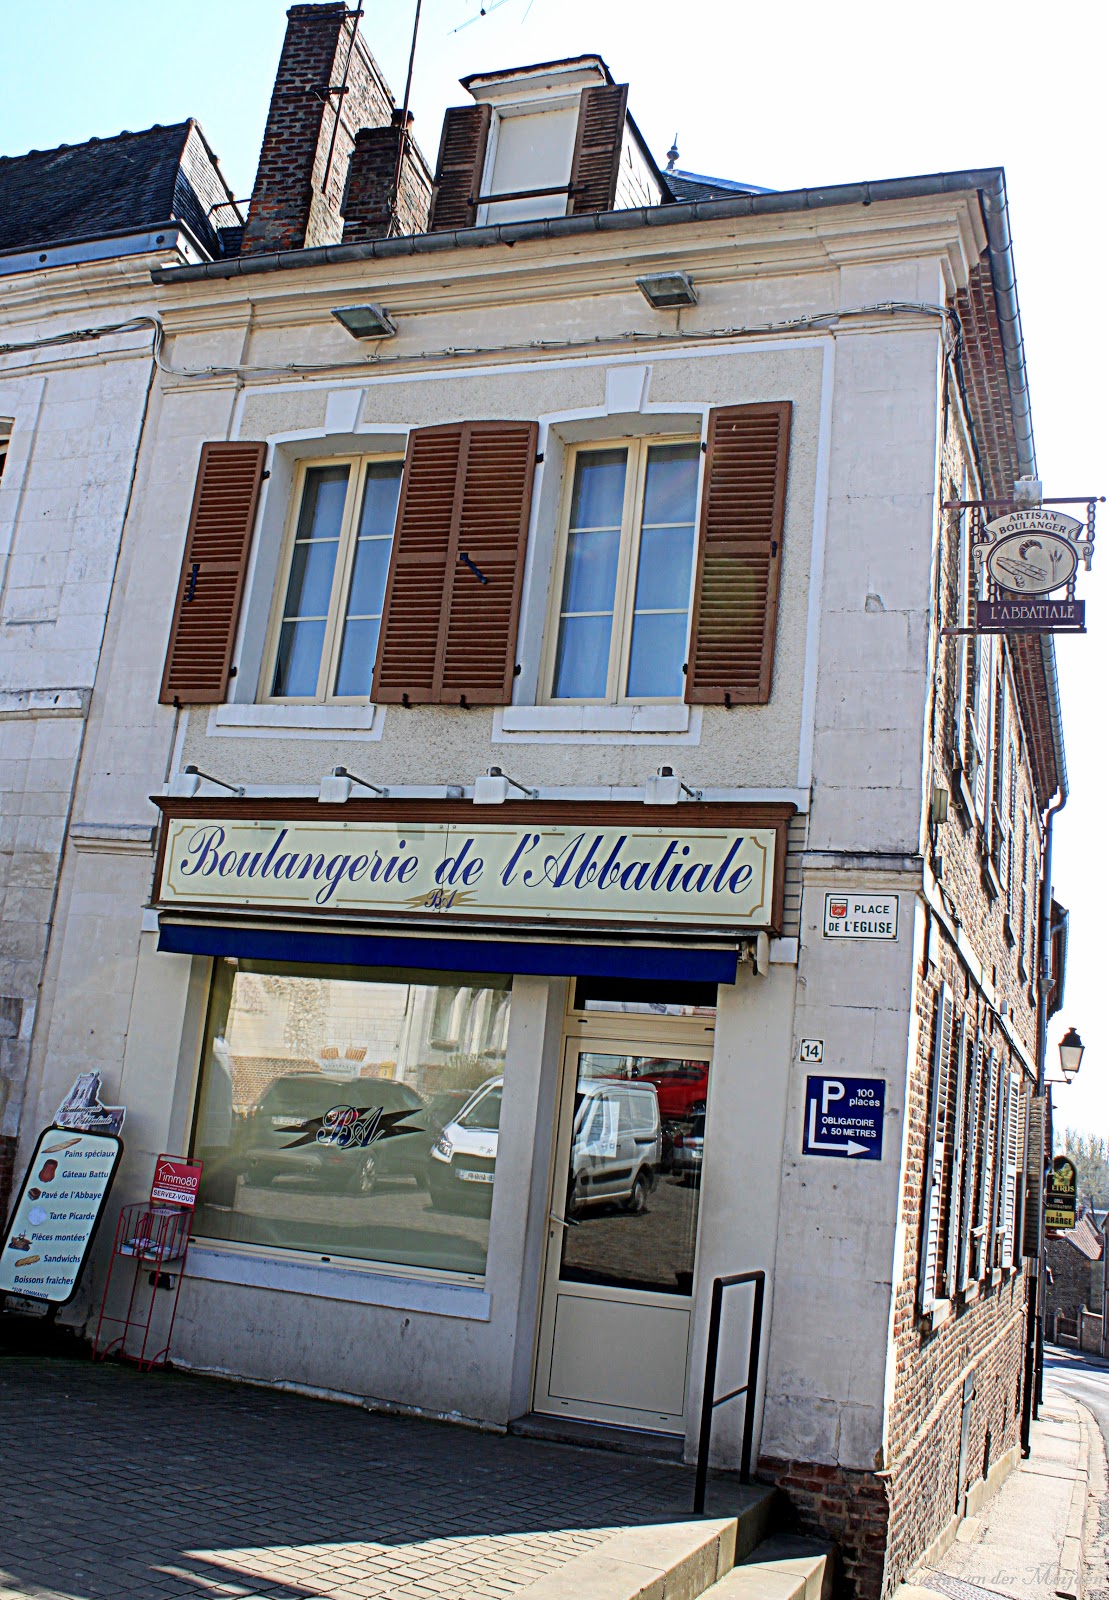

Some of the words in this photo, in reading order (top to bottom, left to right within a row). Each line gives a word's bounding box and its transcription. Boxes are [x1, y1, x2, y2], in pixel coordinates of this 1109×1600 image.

[1009, 512, 1058, 522] ARTISAN
[998, 521, 1067, 535] BOULANGER
[991, 605, 1075, 620] L'ABBATIALE
[180, 825, 419, 905] Boulangerie
[434, 838, 484, 886] de
[499, 833, 753, 895] l'Abbatiale
[854, 904, 890, 914] PLACE
[828, 922, 840, 932] DE
[844, 921, 893, 934] L'EGLISE
[804, 1044, 820, 1058] 14
[821, 1080, 846, 1115] P
[856, 1088, 875, 1098] 100
[849, 1097, 881, 1107] places
[821, 1116, 875, 1127] OBLIGATOIRE
[821, 1127, 828, 1135] A
[830, 1127, 842, 1136] 50
[842, 1128, 877, 1138] METRES
[64, 1150, 83, 1158] Pains
[84, 1150, 116, 1159] spéciaux
[62, 1170, 87, 1178] Gâteau
[88, 1170, 109, 1178] Battu
[41, 1191, 58, 1199] Pavé
[60, 1191, 68, 1199] de
[70, 1191, 102, 1201] l'Abbaye
[153, 1189, 194, 1203] SERVEZ-VOUS
[49, 1211, 67, 1220] Tarte
[68, 1212, 95, 1220] Picarde
[1046, 1216, 1072, 1226] GRANGE
[31, 1232, 53, 1241] Pièces
[43, 1254, 81, 1263] Sandwichs
[13, 1275, 44, 1284] Boissons
[45, 1275, 74, 1285] fraîches
